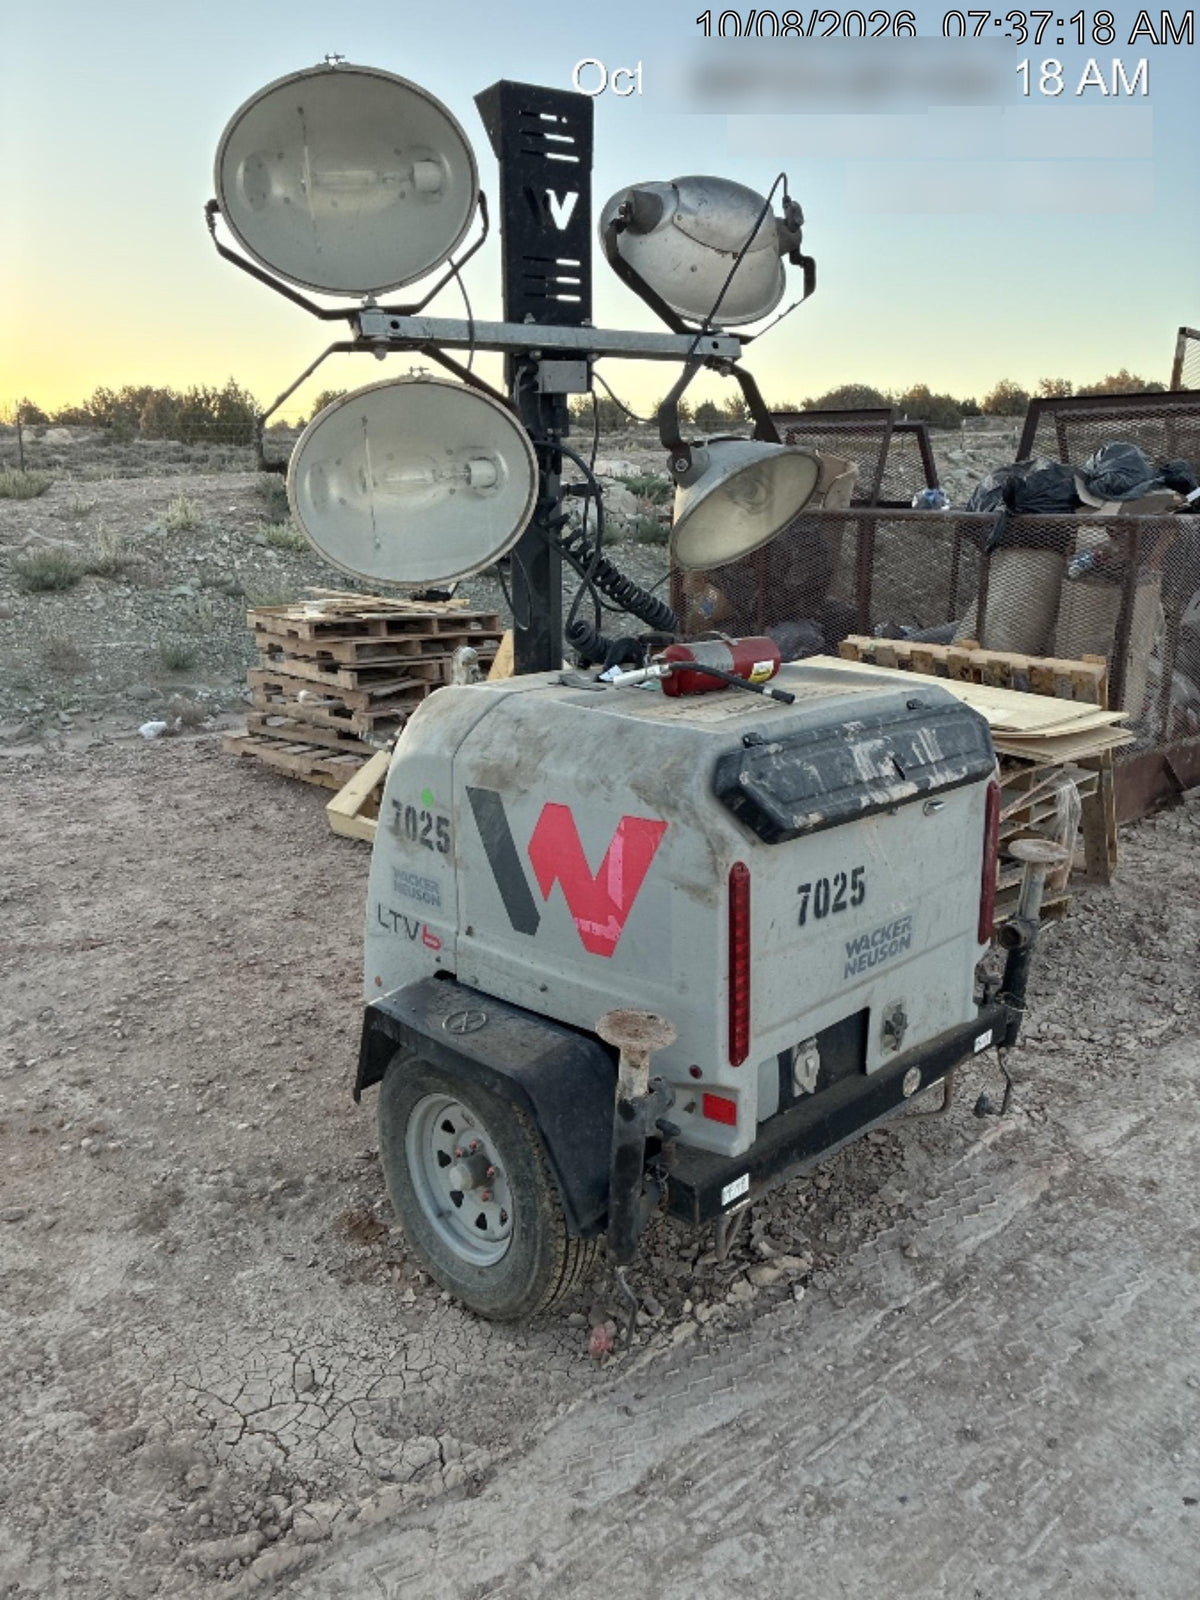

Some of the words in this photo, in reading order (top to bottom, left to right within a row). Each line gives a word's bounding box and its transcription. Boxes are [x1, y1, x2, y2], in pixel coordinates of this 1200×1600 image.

[390, 798, 450, 854] 7025
[797, 865, 865, 927] 7025
[843, 933, 911, 980] NEUSON
[845, 916, 913, 959] WACKER
